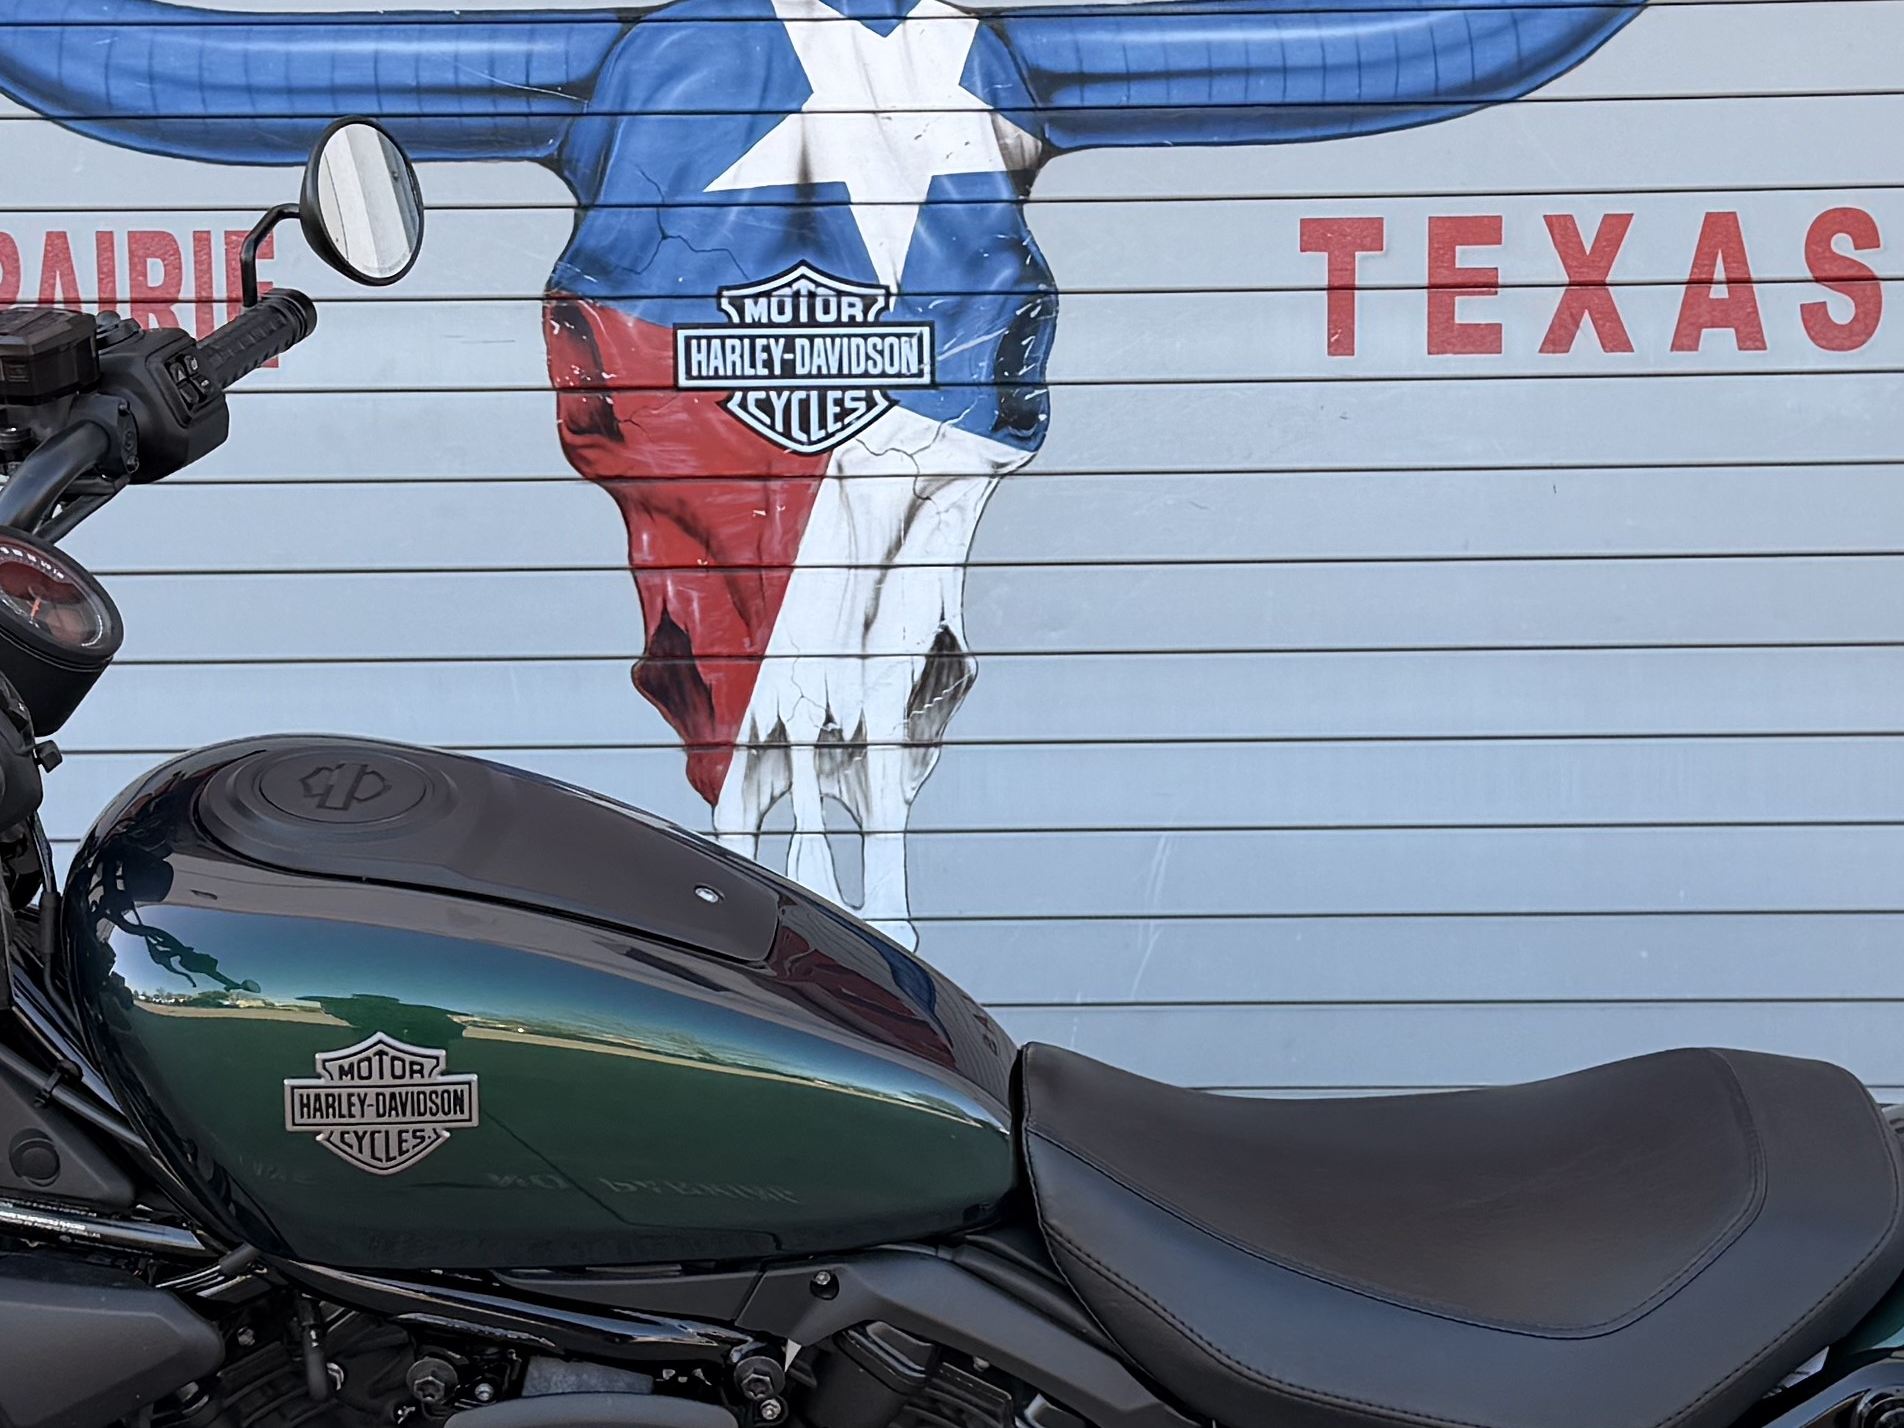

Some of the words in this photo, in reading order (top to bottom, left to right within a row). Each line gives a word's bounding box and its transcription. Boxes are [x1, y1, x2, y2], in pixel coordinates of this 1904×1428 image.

[744, 277, 865, 324] MOTOR
[1299, 207, 1884, 357] TEXAS
[690, 335, 919, 378] HARLEY-DAVIDSON
[746, 389, 867, 443] CYCLES
[338, 1049, 425, 1081] MOTOR
[298, 1088, 465, 1120] HARLEY-DAVIDSON
[339, 1127, 427, 1163] CYCLES
